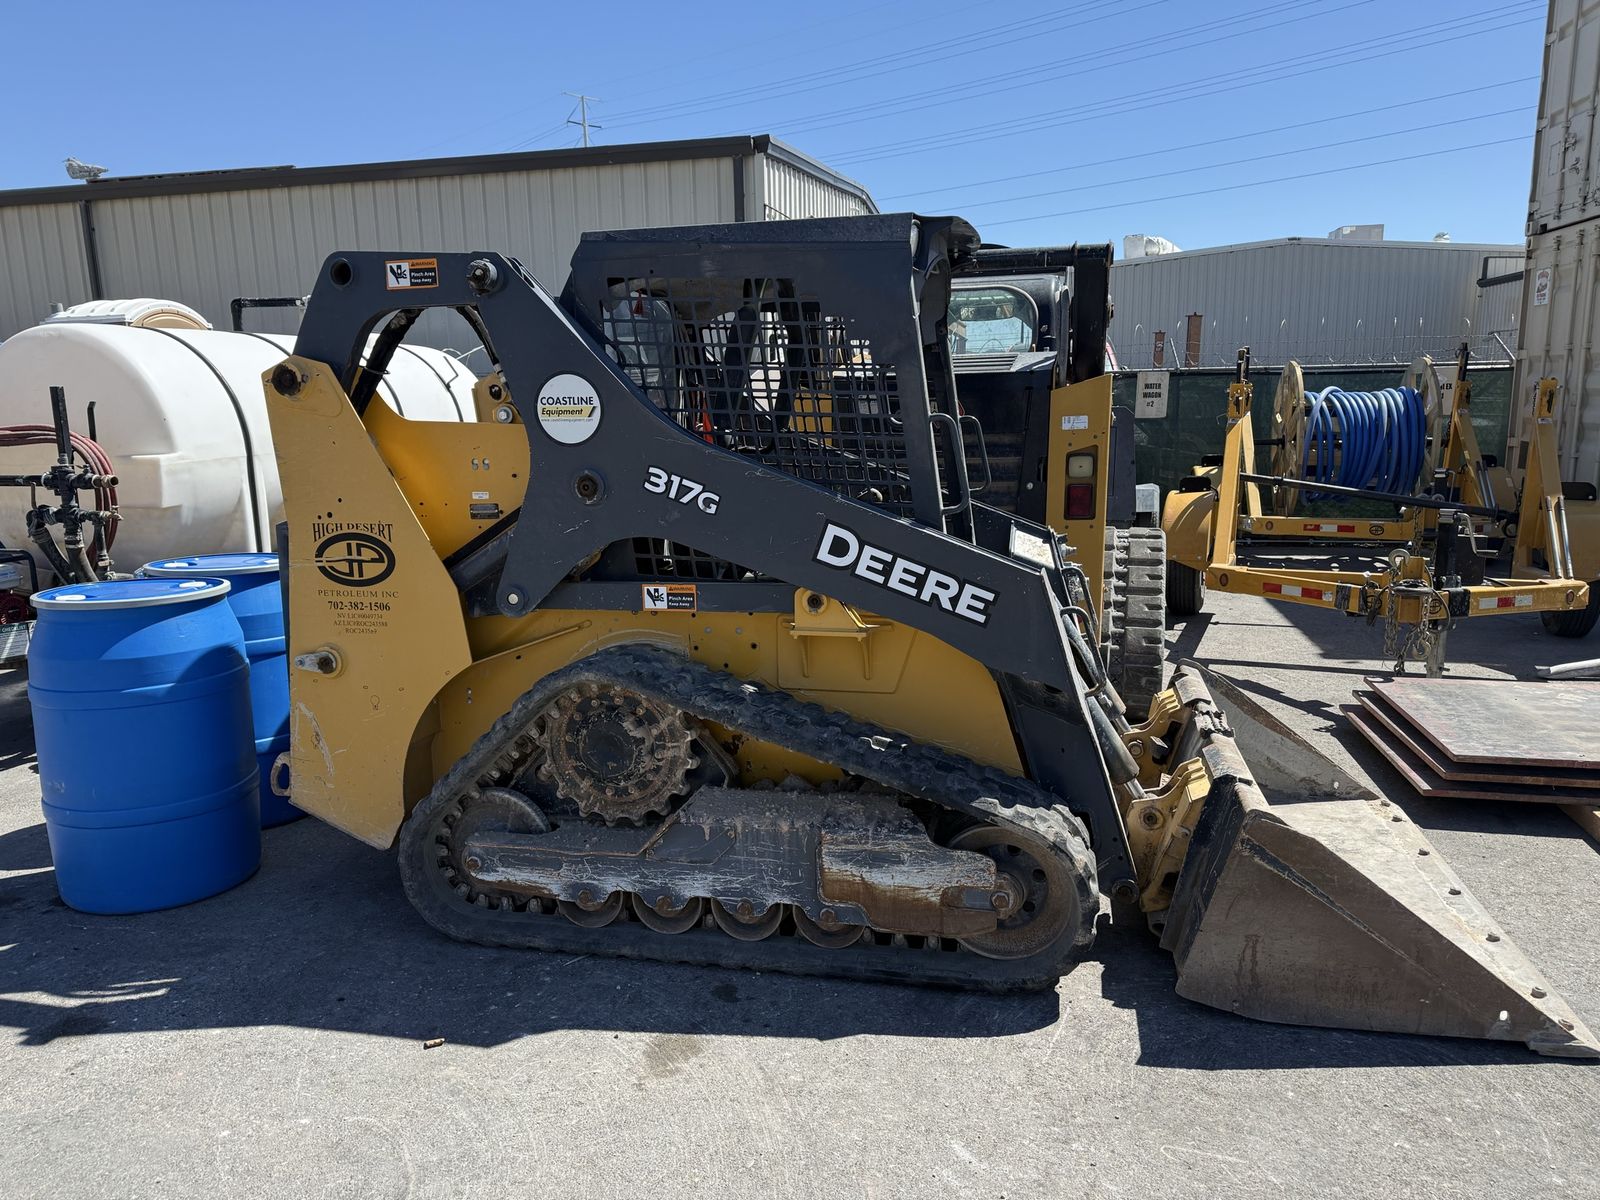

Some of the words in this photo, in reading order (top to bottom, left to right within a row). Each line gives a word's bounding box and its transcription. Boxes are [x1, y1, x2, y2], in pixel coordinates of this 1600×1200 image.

[540, 396, 594, 406] COASTLINE
[541, 407, 584, 417] Equipment
[643, 466, 720, 515] 317G
[312, 522, 343, 542] HIGH
[346, 522, 394, 543] DESERT
[815, 523, 996, 624] DEERE
[318, 589, 378, 598] PETROLEUM
[328, 600, 391, 611] 702-382-1506
